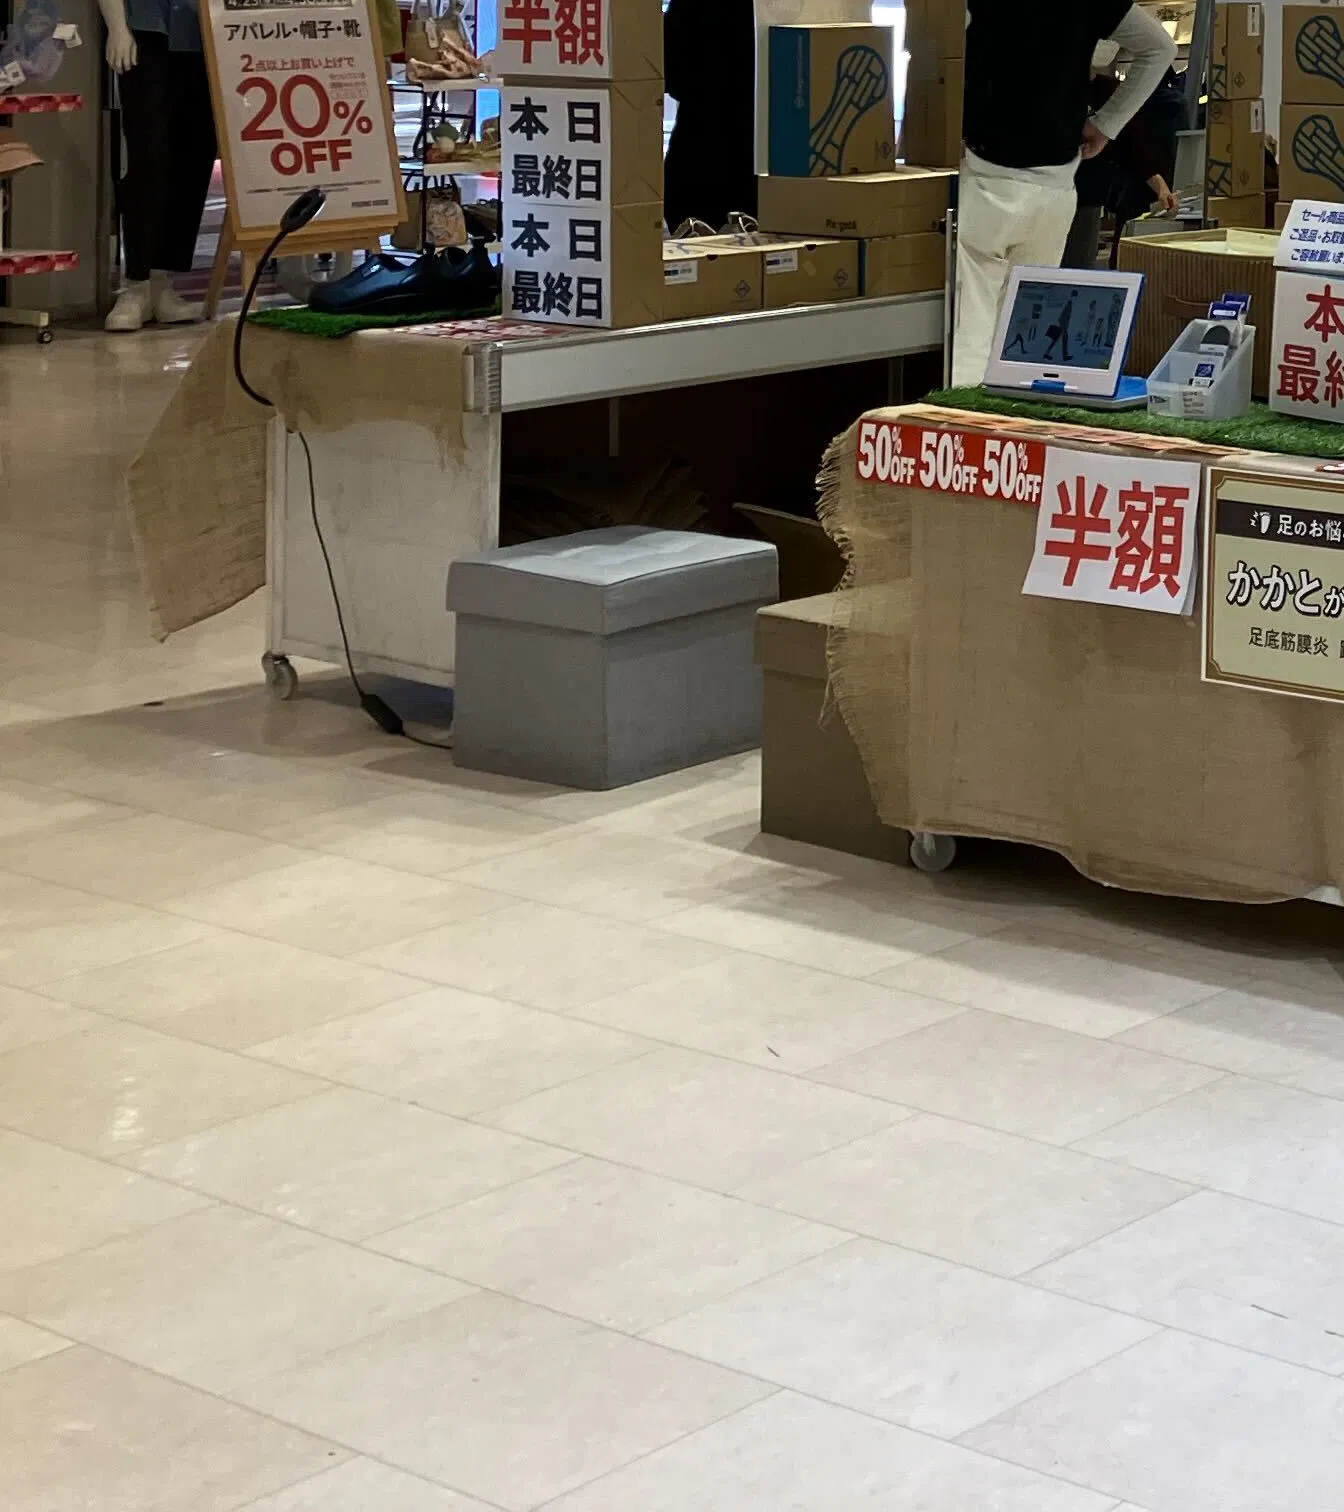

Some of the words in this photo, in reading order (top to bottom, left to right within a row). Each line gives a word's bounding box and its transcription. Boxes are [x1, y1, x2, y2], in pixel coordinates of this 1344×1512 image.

[223, 19, 363, 42] アパレル・帽子・靴
[235, 74, 373, 142] 20%
[508, 96, 601, 143] 本日
[270, 138, 353, 176] OFF
[511, 154, 603, 201] 最終日
[510, 213, 602, 262] 本日
[511, 270, 603, 319] 最終日
[1042, 475, 1191, 599] 半額
[1248, 626, 1329, 658] 足底筋膜炎
